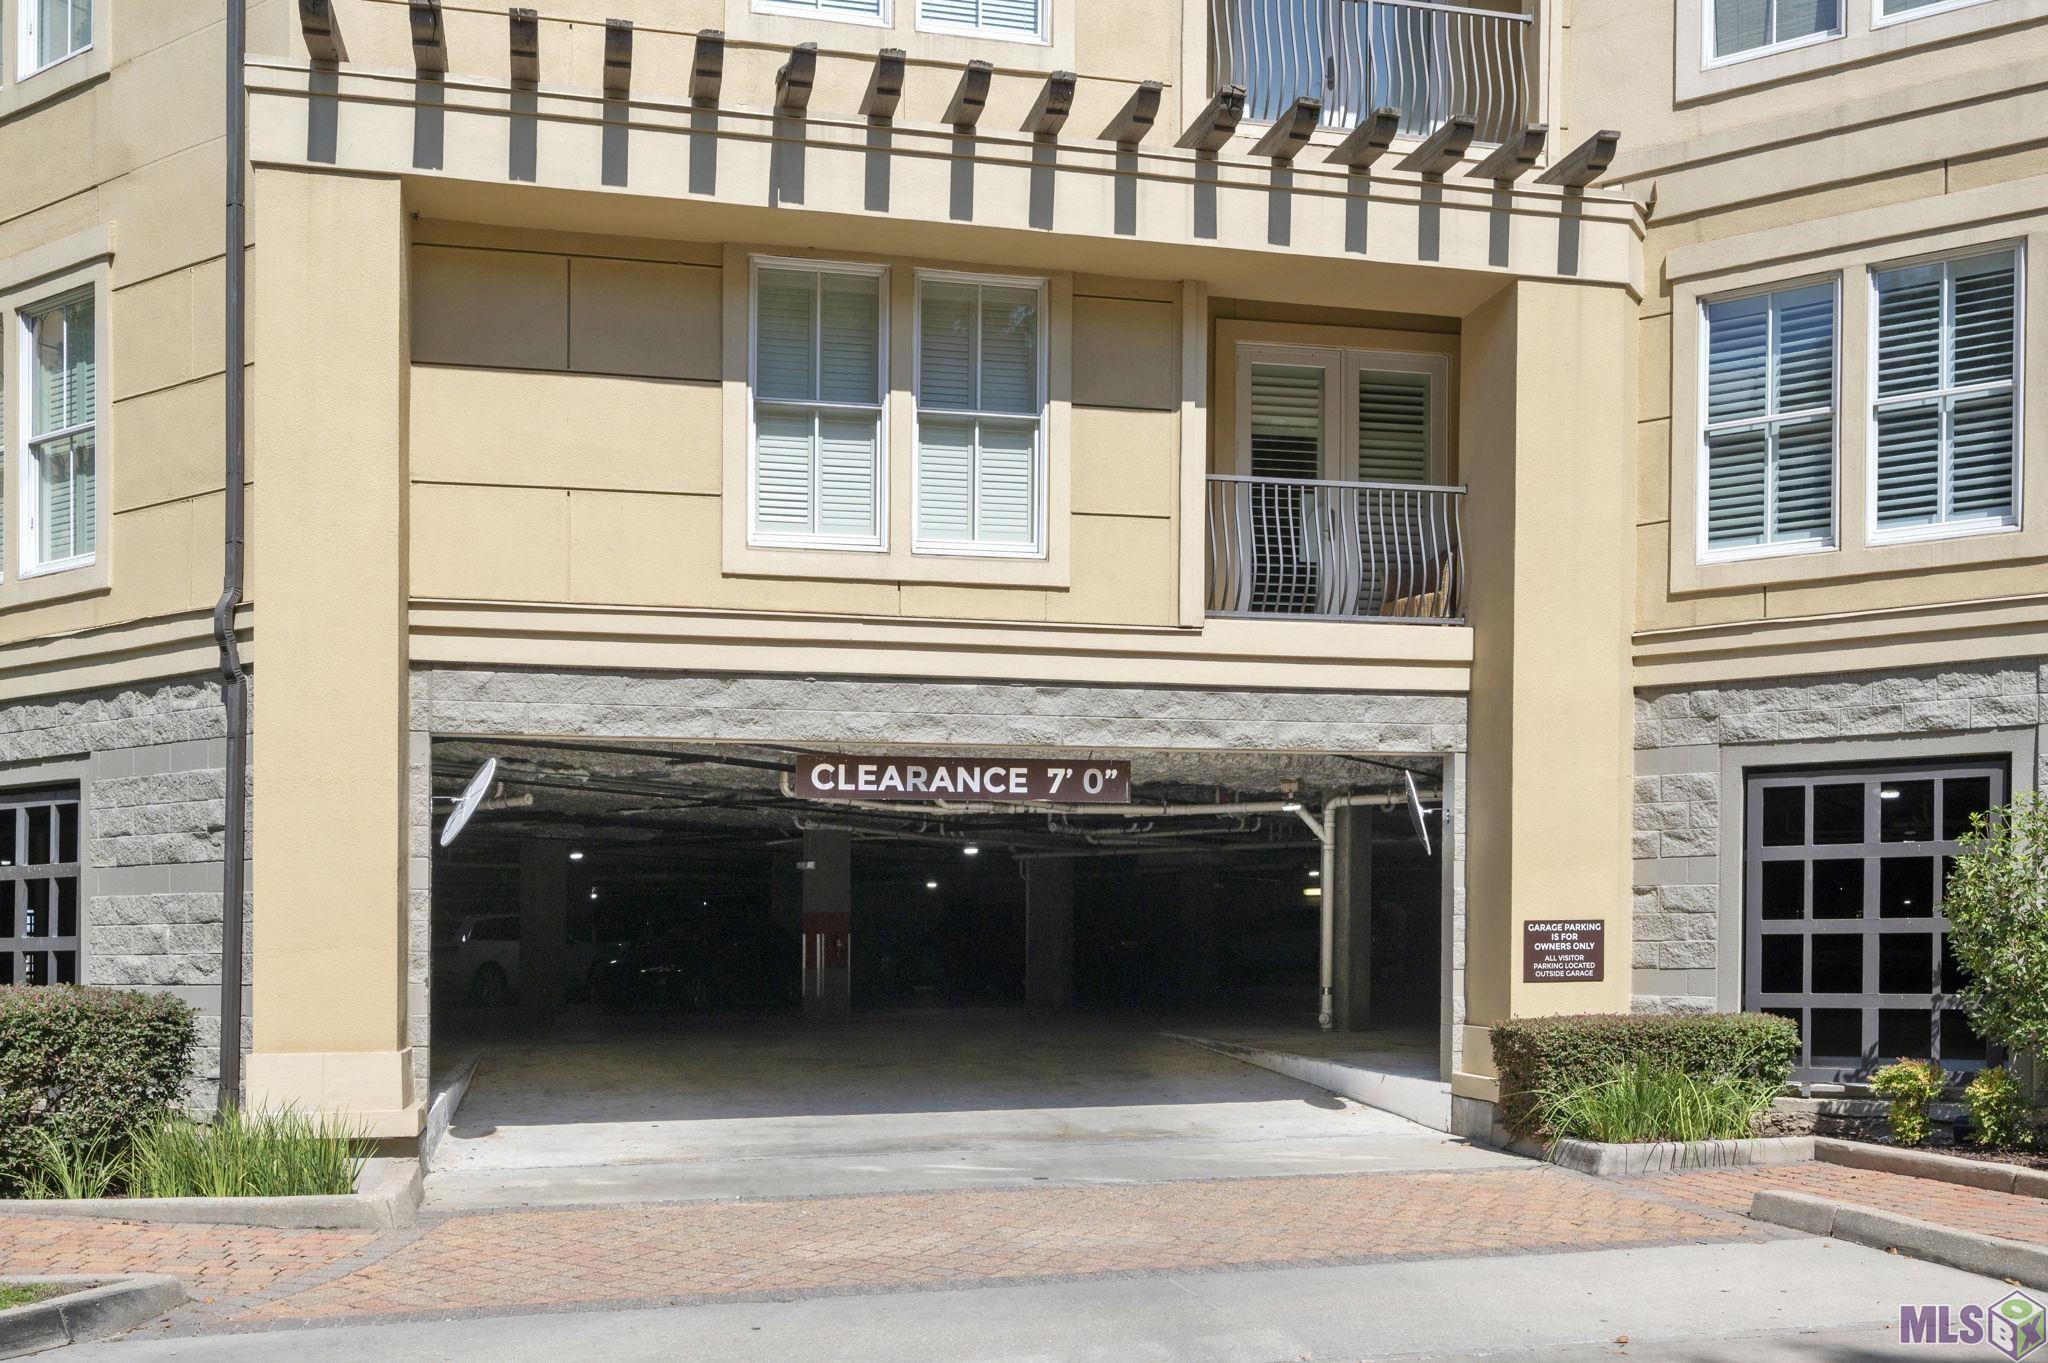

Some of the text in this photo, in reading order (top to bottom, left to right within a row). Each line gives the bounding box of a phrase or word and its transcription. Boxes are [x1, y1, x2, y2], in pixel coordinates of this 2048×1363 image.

[811, 763, 1028, 794] CLEARANCE
[1565, 923, 1601, 931] PARKING
[1551, 933, 1578, 941] IS FOR
[1534, 942, 1595, 951] OWNERS ONLY
